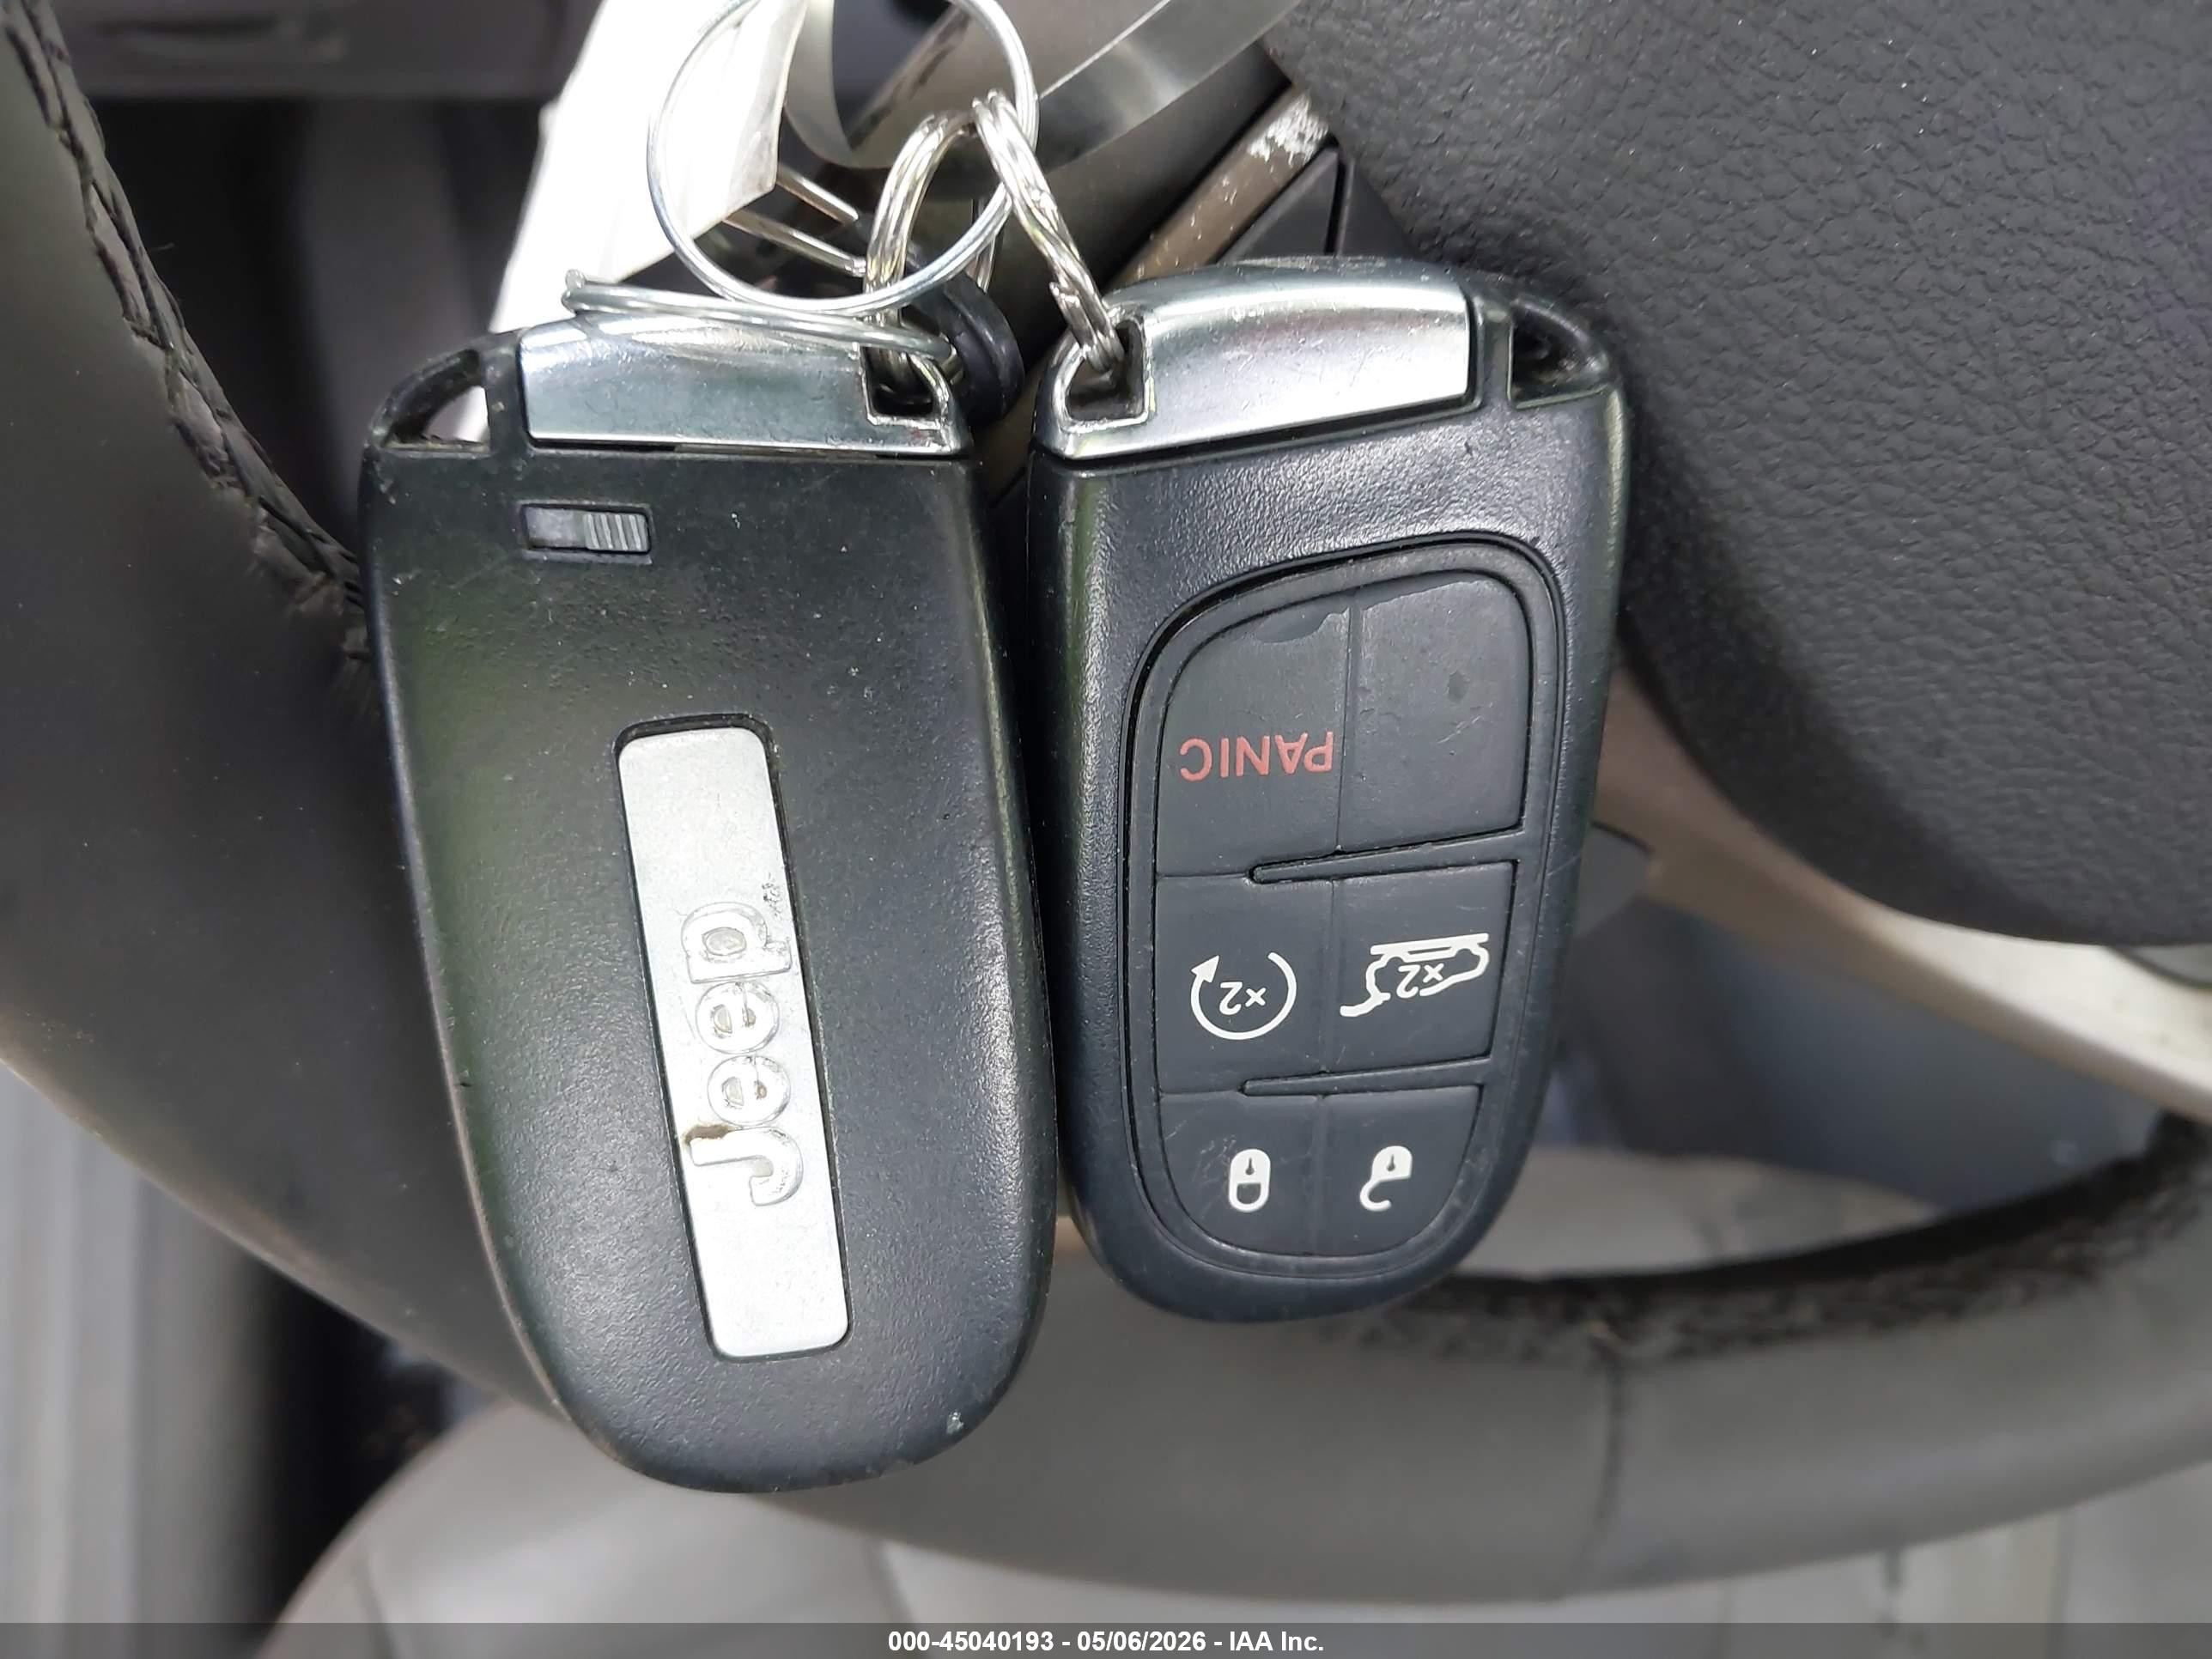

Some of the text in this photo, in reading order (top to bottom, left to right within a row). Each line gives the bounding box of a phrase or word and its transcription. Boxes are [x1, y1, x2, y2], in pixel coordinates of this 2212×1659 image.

[1179, 732, 1334, 782] PANIC
[1218, 981, 1267, 1016] x2
[1396, 962, 1445, 999] x2
[681, 901, 805, 1206] Jeep
